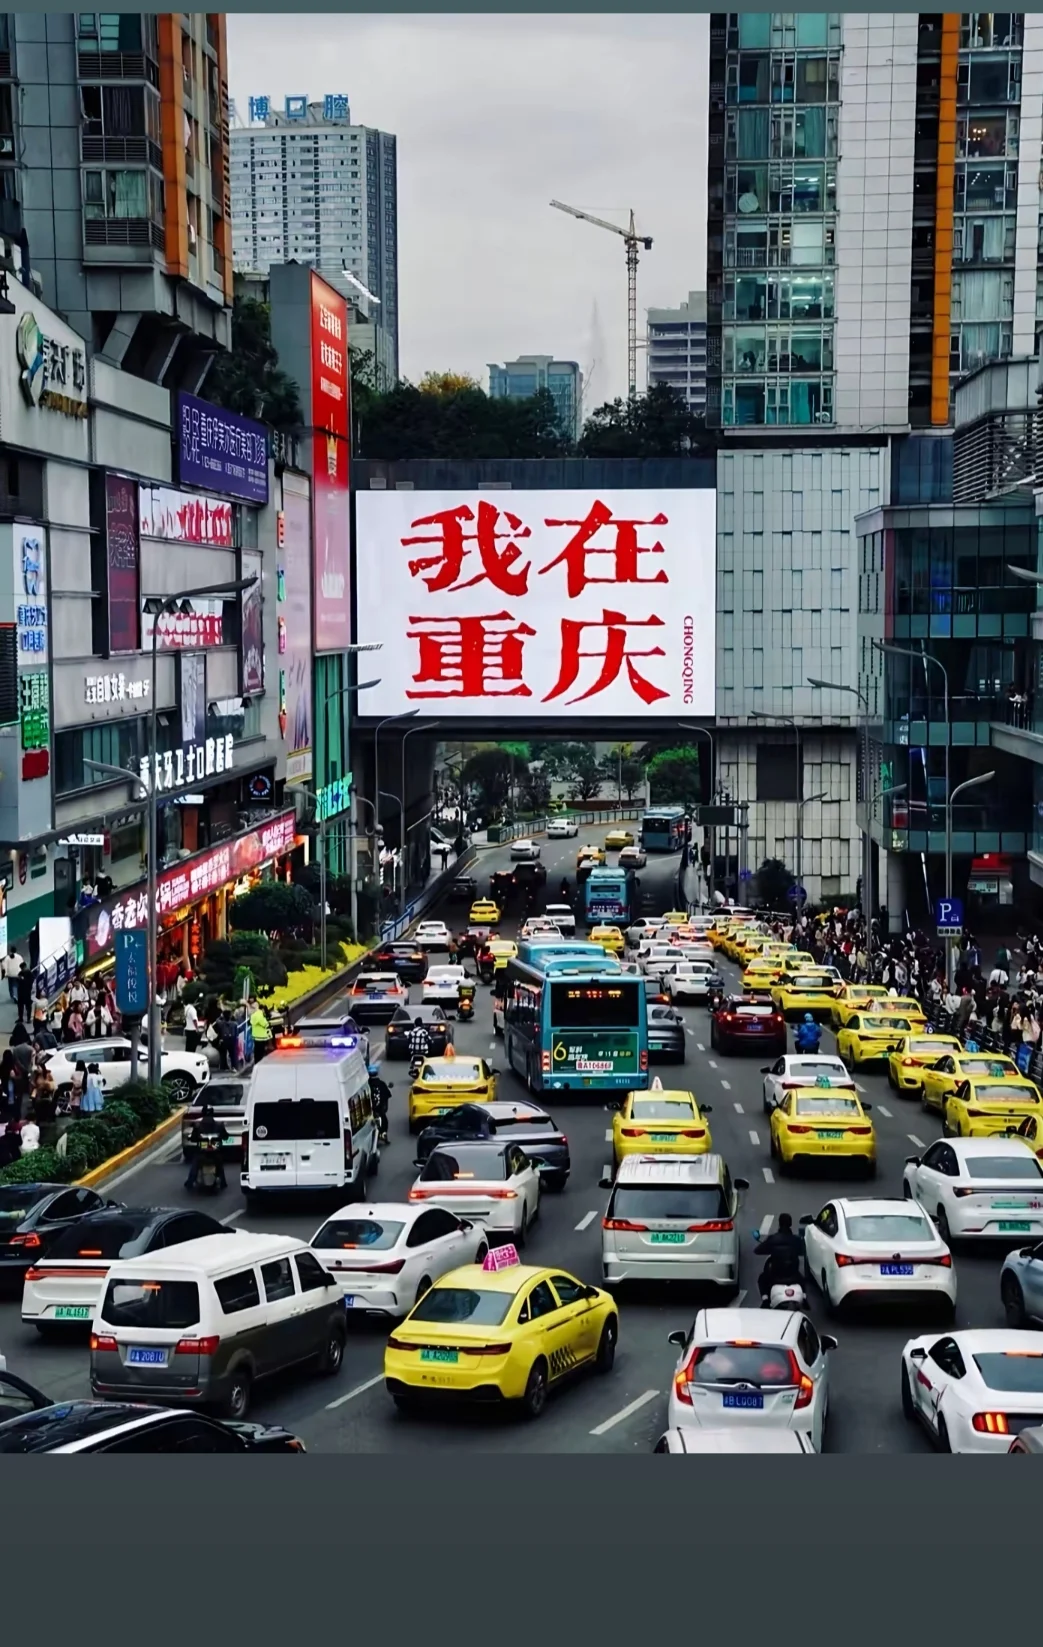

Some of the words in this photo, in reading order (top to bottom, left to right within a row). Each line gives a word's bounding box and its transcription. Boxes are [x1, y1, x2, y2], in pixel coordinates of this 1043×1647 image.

[400, 500, 669, 598] 我在
[405, 609, 671, 705] 重庆
[682, 615, 694, 704] CHONGQING
[940, 903, 952, 922] P
[124, 934, 135, 949] P
[553, 1041, 567, 1061] 6
